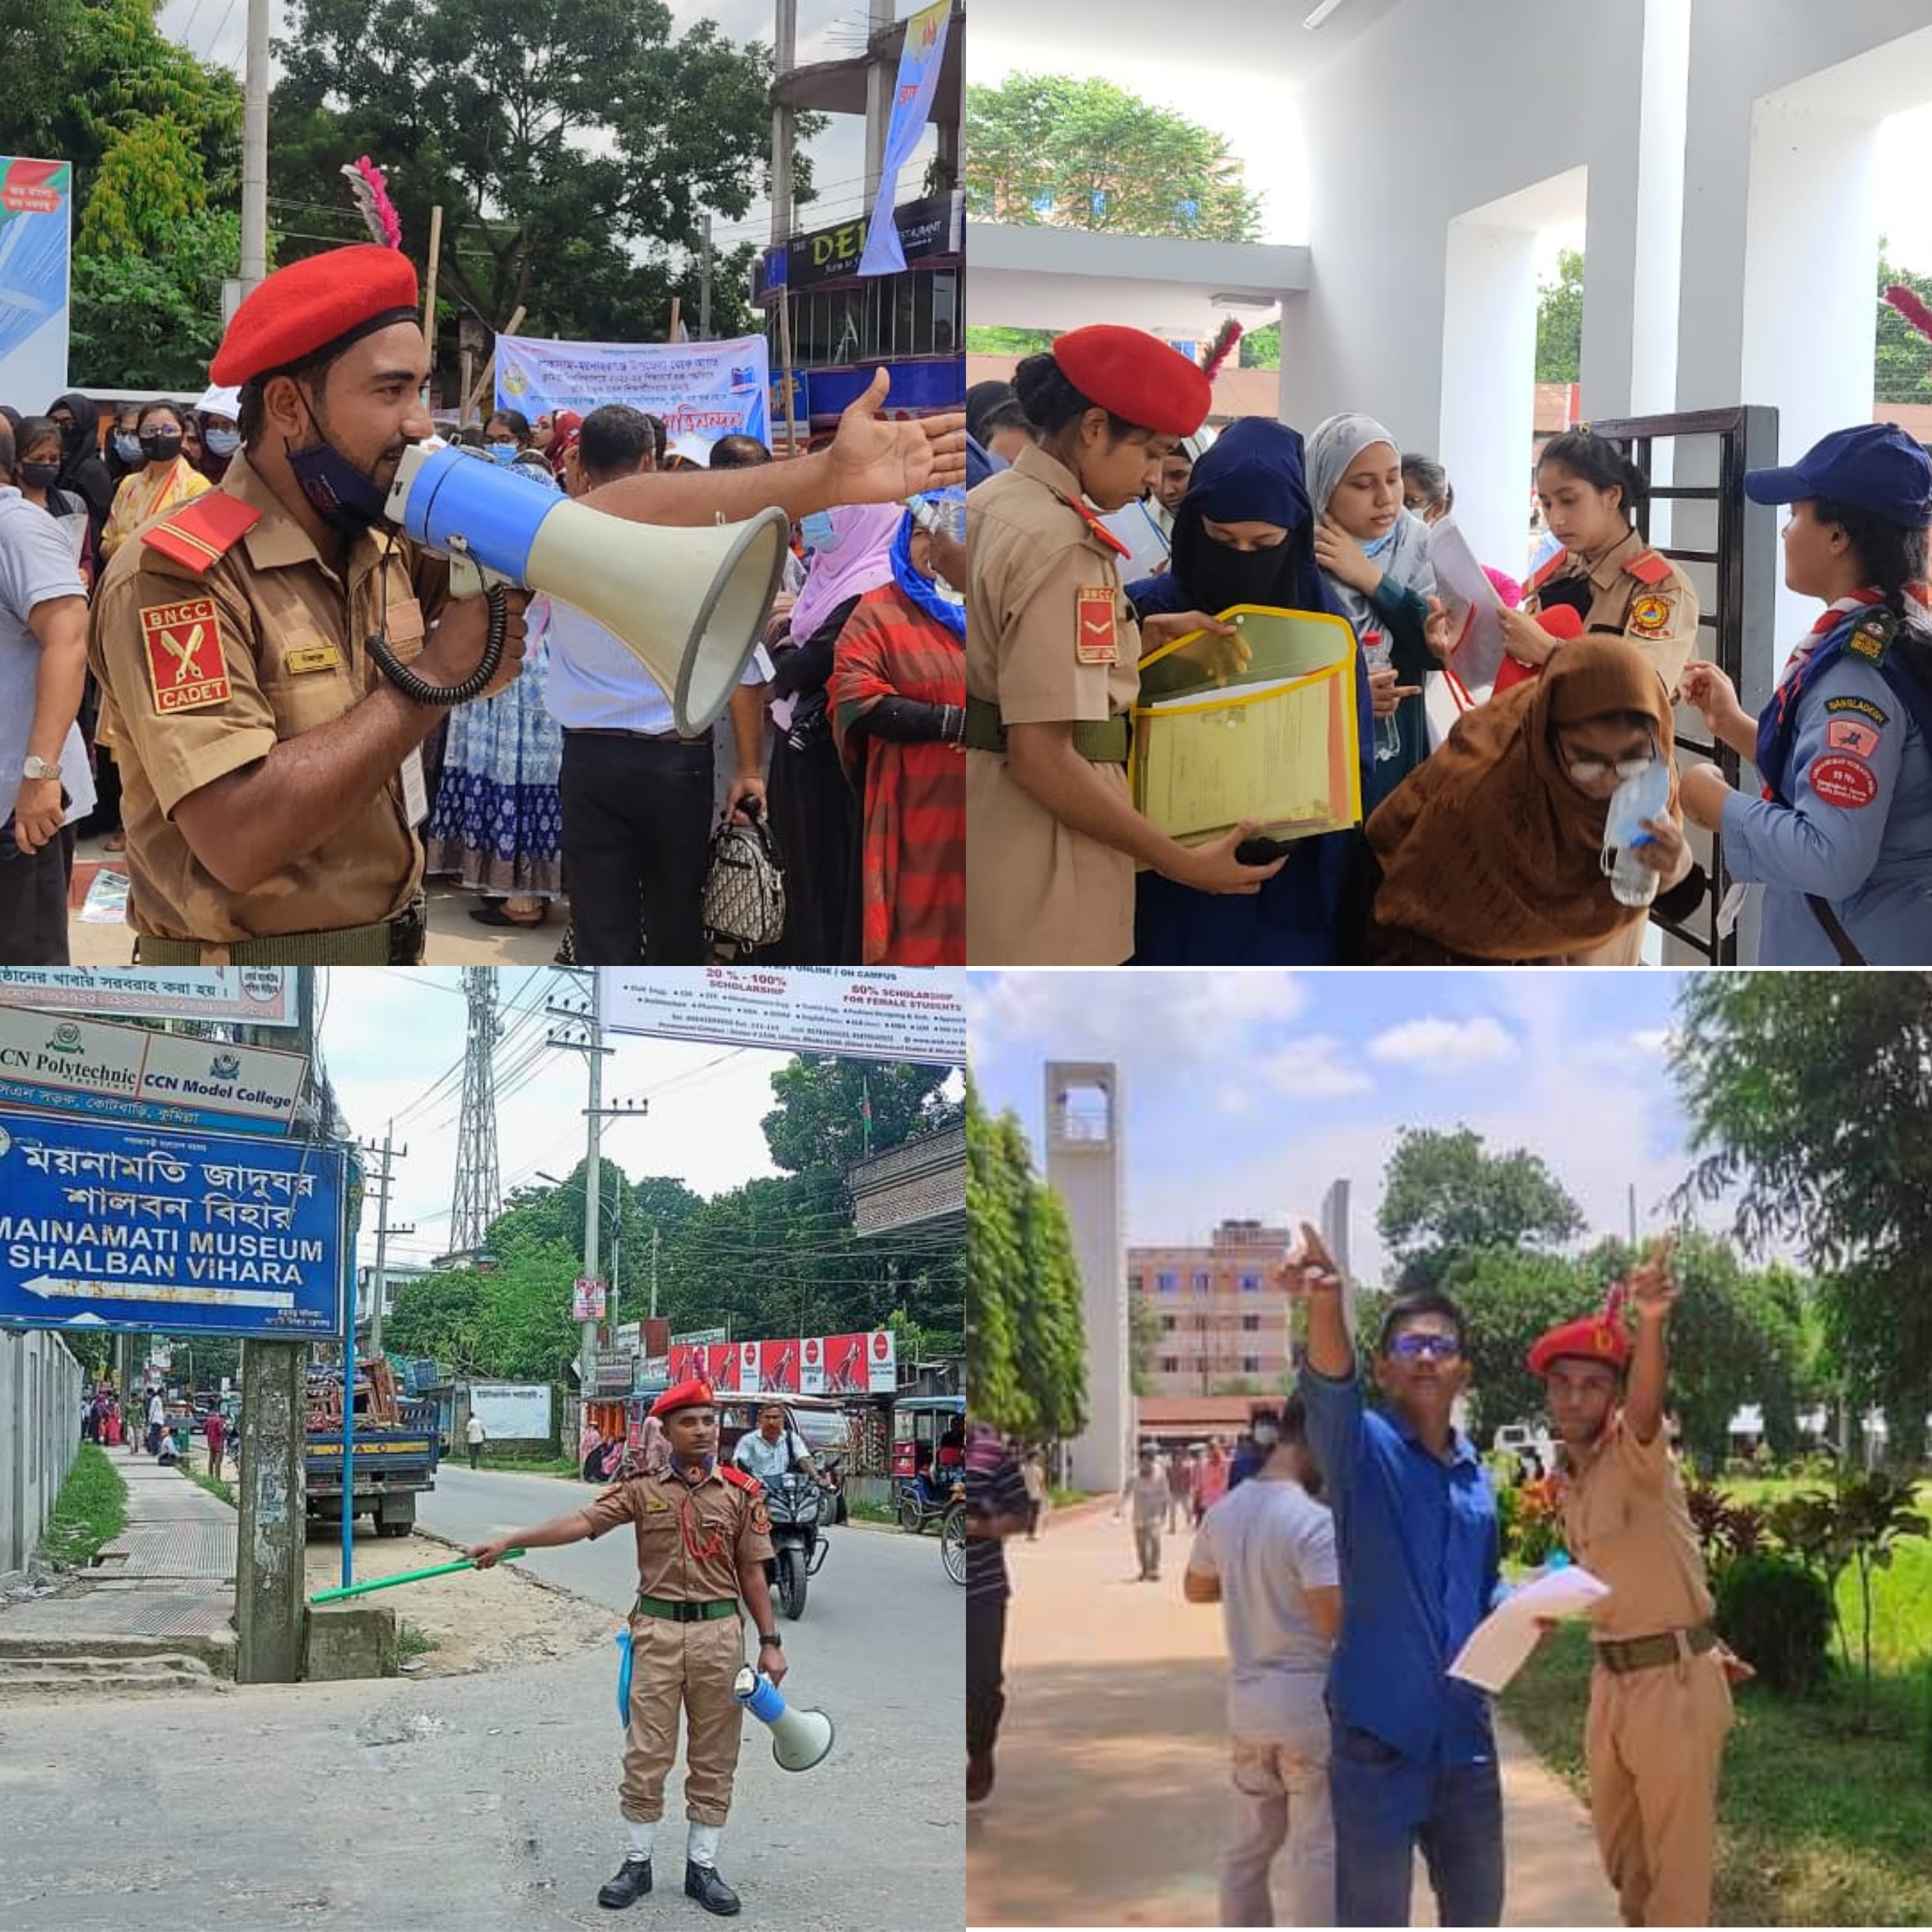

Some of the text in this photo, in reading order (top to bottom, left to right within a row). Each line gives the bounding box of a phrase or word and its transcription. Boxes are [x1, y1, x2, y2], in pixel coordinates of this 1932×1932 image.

[149, 603, 209, 627] BNCC
[163, 683, 224, 707] CADET
[707, 967, 722, 978] 20
[752, 973, 787, 987] 100%
[709, 980, 785, 995] SCHOLARSHIP
[857, 971, 897, 981] CAMPUS
[843, 995, 961, 1011] FOR FEMALE STUDENTS
[882, 989, 953, 1000] SCHOLARSHIP
[36, 1053, 136, 1085] Polytechnic
[145, 1074, 178, 1090] CCN
[183, 1080, 232, 1099] Model
[237, 1088, 291, 1109] College
[20, 1141, 191, 1184] ময়নামতি
[201, 1163, 317, 1198] জাদুঘর
[63, 1187, 297, 1231] শালবন বিহার
[190, 1231, 323, 1262] MUSEUM
[9, 1244, 304, 1286] SHALBAN VIHARA
